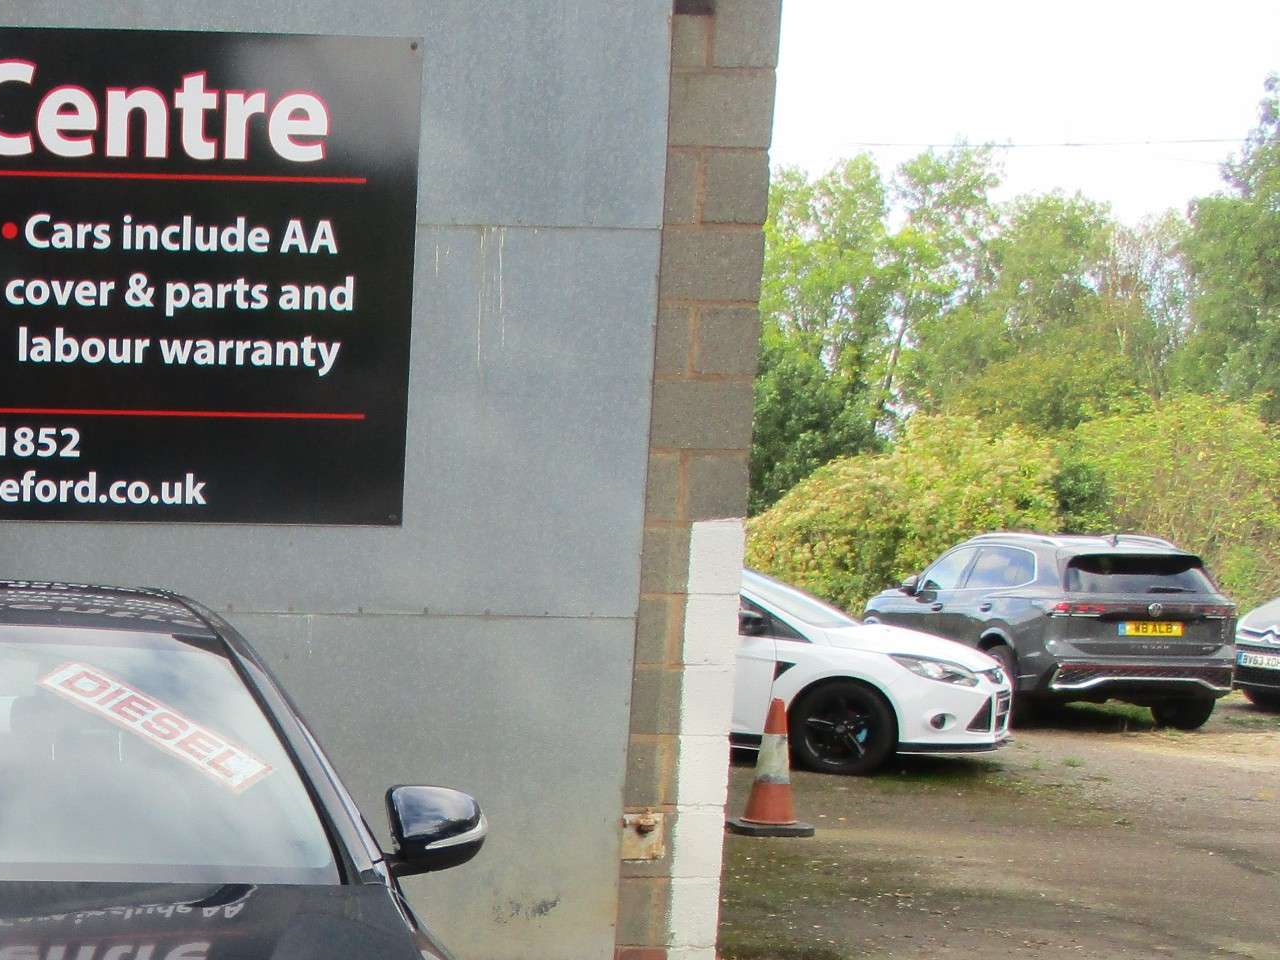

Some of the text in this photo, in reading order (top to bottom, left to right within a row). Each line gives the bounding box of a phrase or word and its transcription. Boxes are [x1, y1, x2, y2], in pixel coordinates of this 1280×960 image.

[24, 213, 338, 255] Cars include AA
[5, 272, 355, 317] cover & parts and
[18, 327, 341, 377] labour warranty
[59, 671, 236, 778] DIESEL
